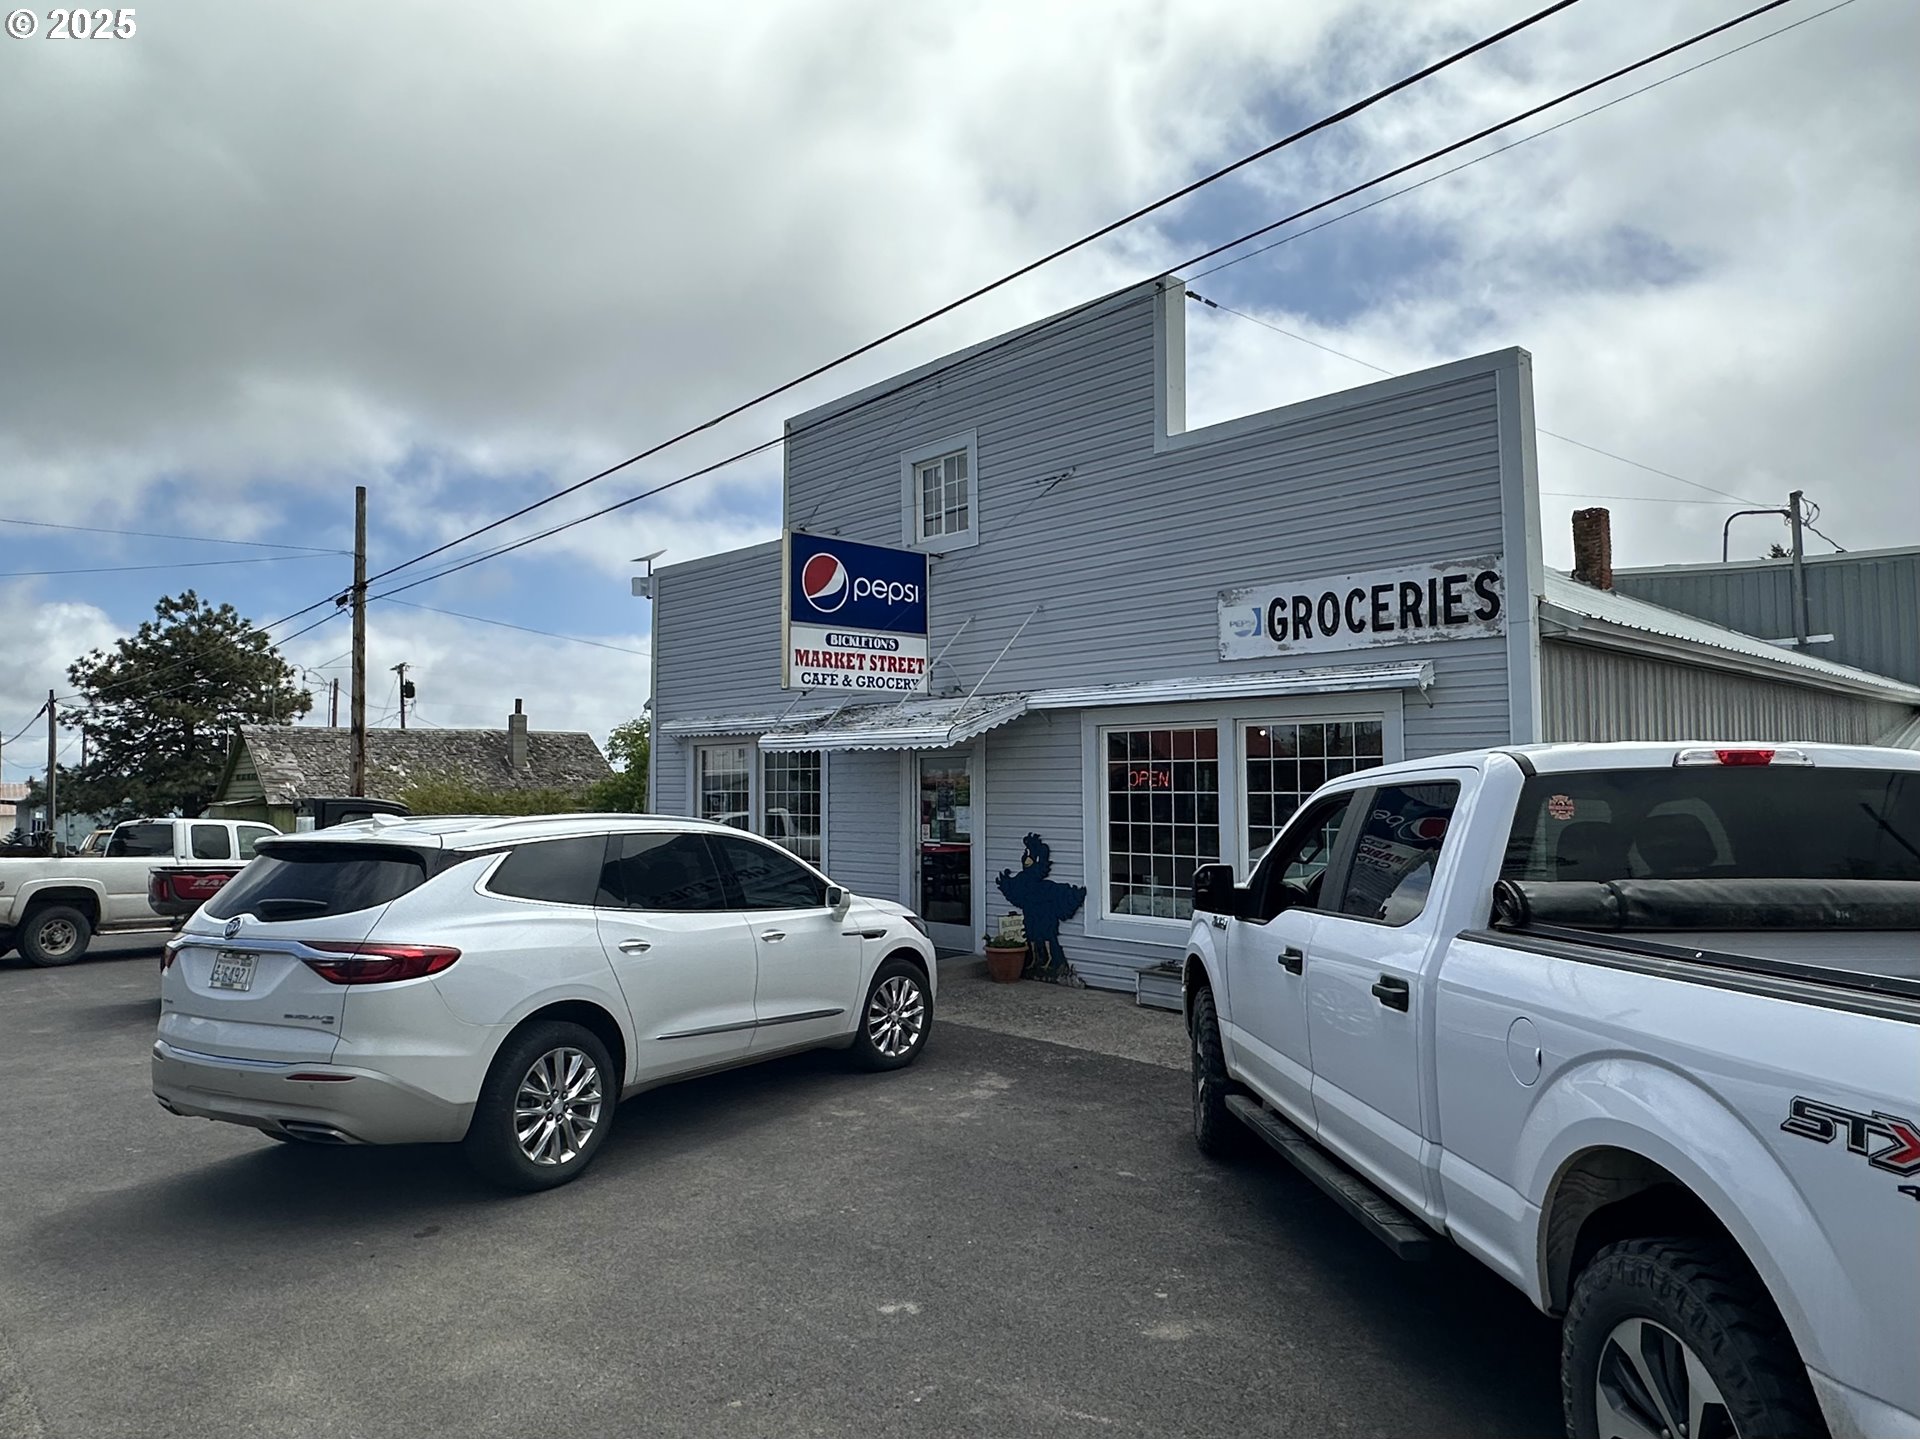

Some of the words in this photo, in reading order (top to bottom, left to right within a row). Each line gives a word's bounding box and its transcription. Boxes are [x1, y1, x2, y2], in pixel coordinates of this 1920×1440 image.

[853, 577, 919, 606] pepsi
[1268, 570, 1501, 642] GROCERIES
[795, 649, 866, 671] MARKET
[869, 654, 925, 674] STREET
[801, 672, 839, 686] CAFE
[842, 675, 852, 687] &
[856, 675, 919, 690] GROCERY
[1128, 770, 1169, 787] OPEN
